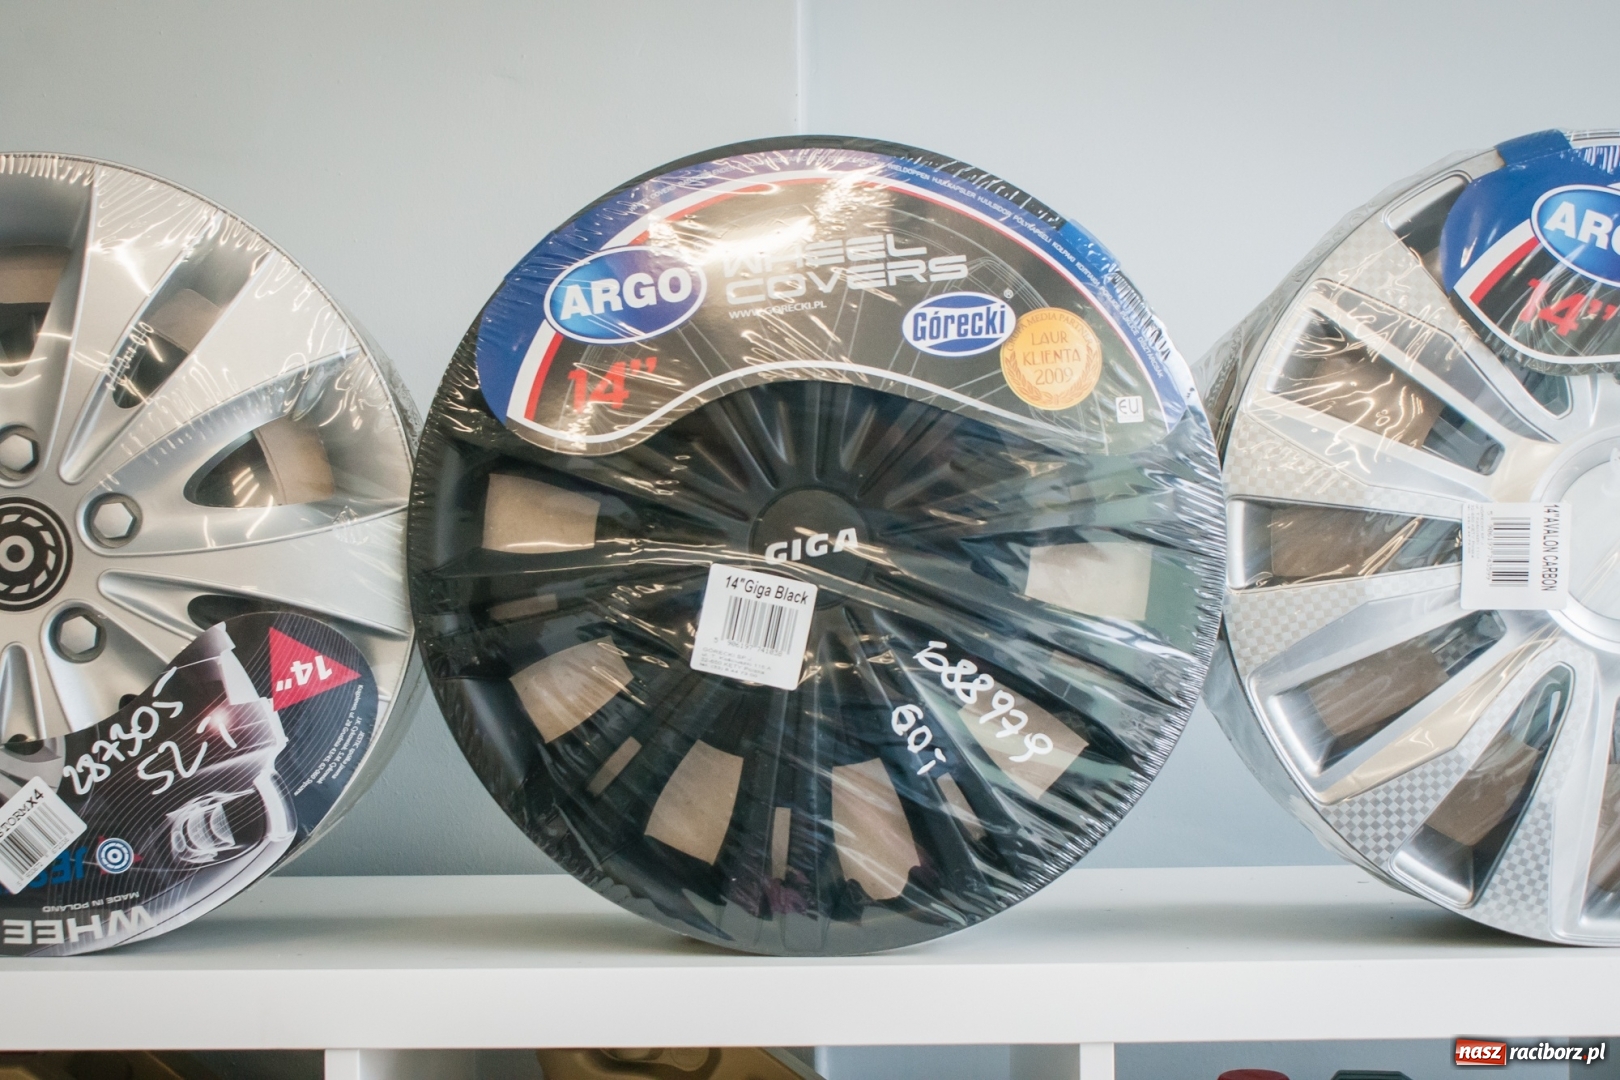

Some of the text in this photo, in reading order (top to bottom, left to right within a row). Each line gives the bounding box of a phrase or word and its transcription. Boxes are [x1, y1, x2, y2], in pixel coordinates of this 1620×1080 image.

[1543, 200, 1620, 256] AR
[721, 233, 928, 278] WHEEL
[560, 267, 693, 320] ARGO
[725, 254, 968, 305] COVERS
[912, 303, 1006, 342] Górecki
[1026, 312, 1057, 326] MEDIA
[1059, 313, 1093, 345] PARTNER
[1031, 330, 1069, 346] LAUR
[1022, 348, 1082, 366] KLIENTA
[568, 356, 658, 415] 14"
[1033, 367, 1074, 386] 2009
[765, 527, 860, 565] GIGA
[1541, 555, 1559, 592] CARBON
[774, 585, 809, 605] Black
[276, 655, 333, 692] 14"
[42, 891, 140, 913] MADE IN POLAND
